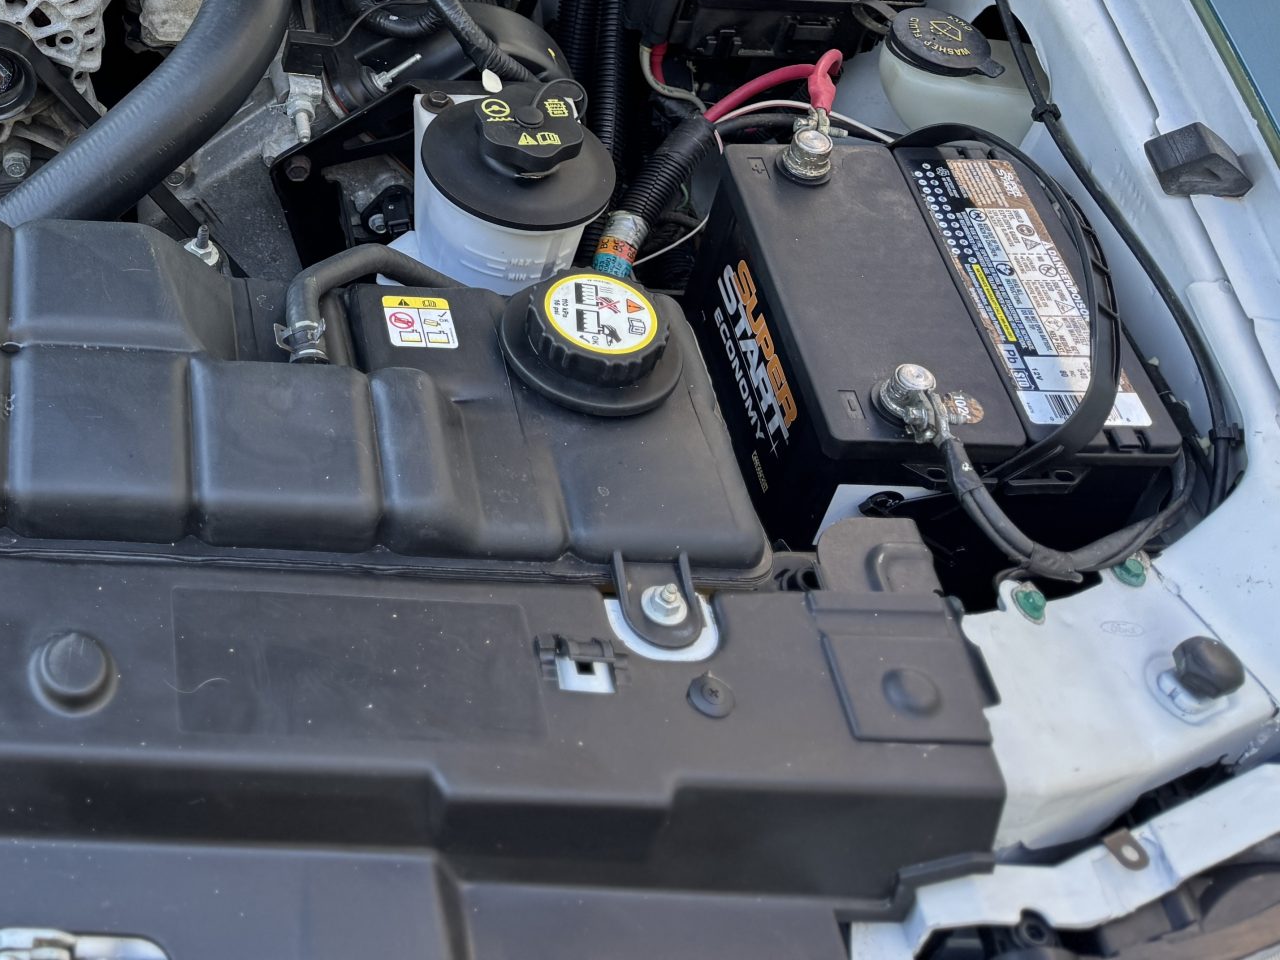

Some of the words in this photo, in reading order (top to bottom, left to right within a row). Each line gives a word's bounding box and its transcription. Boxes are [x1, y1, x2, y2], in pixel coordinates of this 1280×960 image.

[908, 17, 922, 38] FLUID
[923, 40, 971, 57] WASHER
[1046, 249, 1093, 321] DANGER/POISON
[718, 264, 789, 446] START
[733, 259, 797, 428] SUPER
[1002, 349, 1020, 363] Pb
[714, 306, 765, 440] ECONOMY
[1030, 368, 1043, 380] 12V
